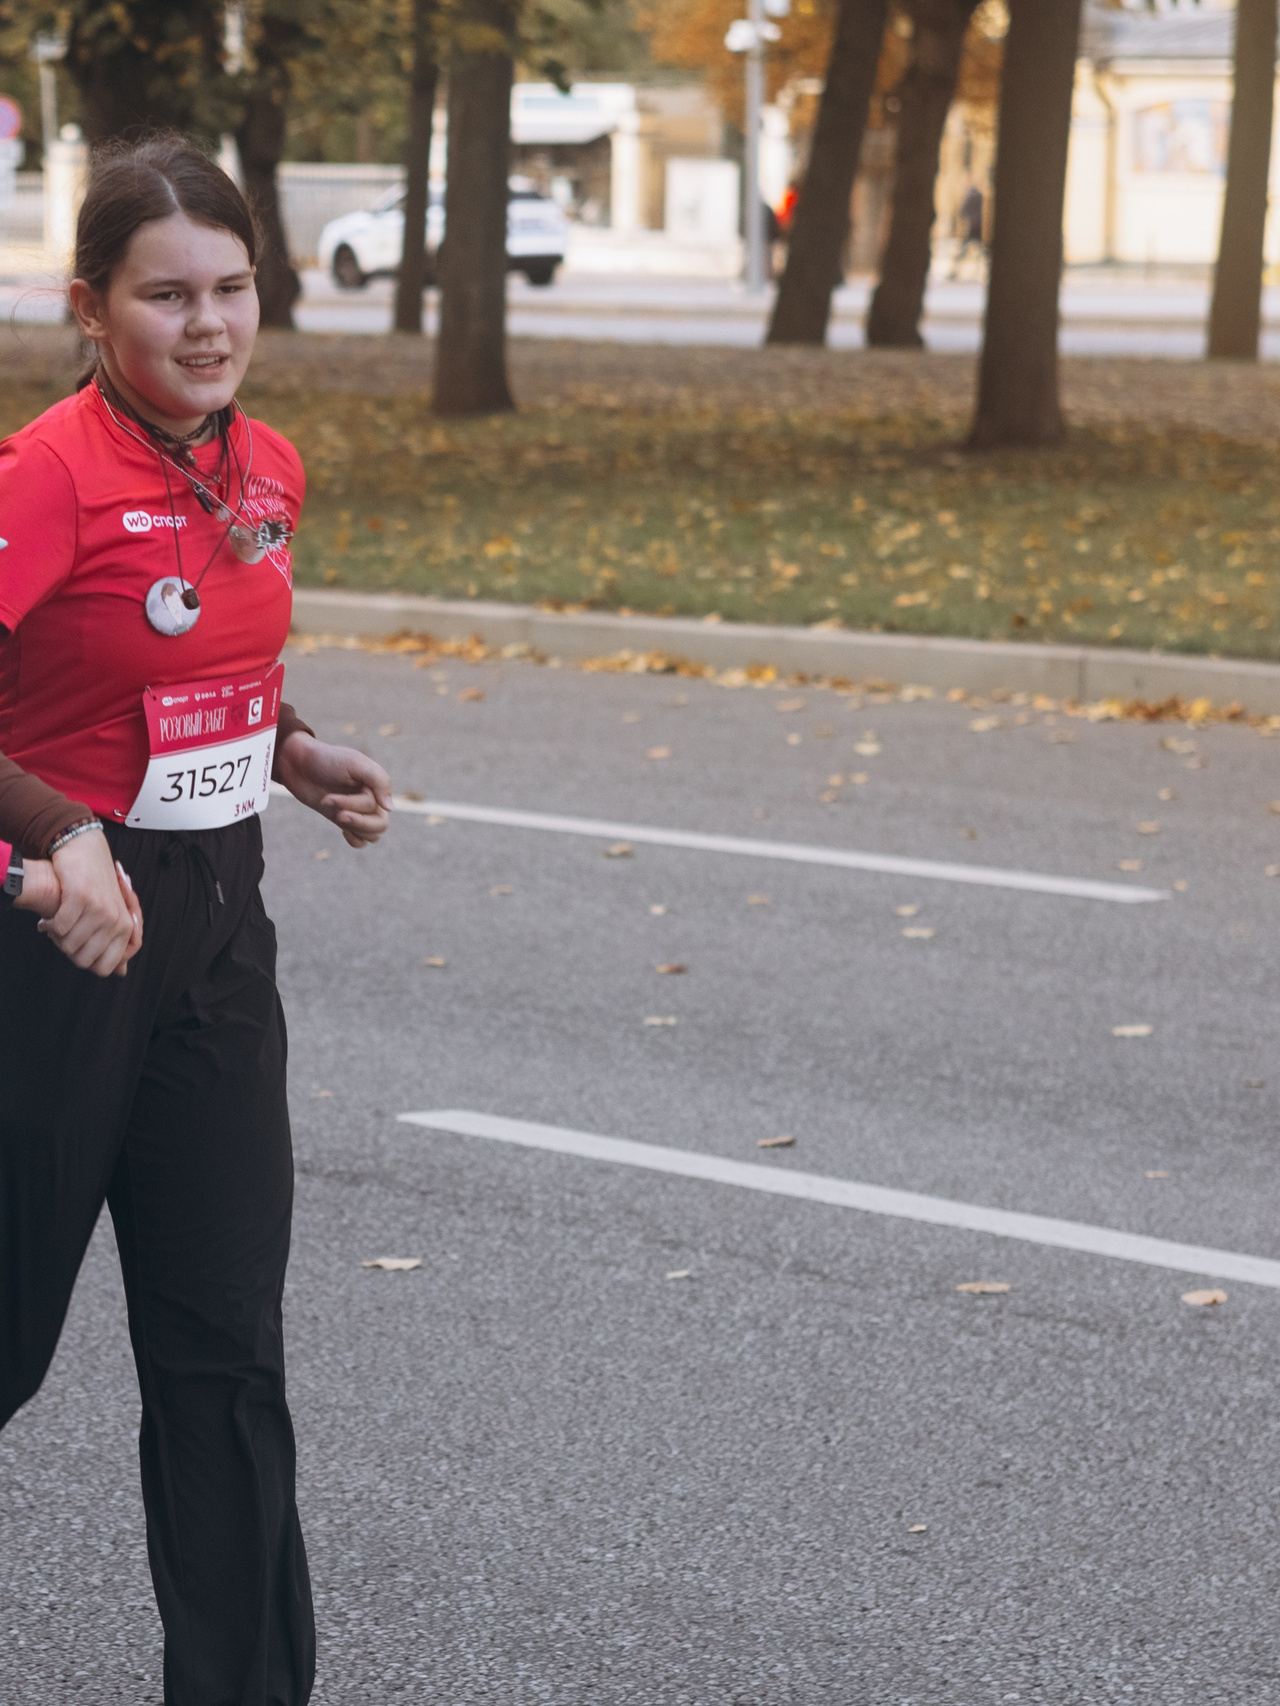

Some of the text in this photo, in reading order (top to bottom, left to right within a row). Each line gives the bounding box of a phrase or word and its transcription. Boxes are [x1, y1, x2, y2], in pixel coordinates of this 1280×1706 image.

[160, 707, 228, 742] РОЗОВЫЙ ЗАБЕГ
[160, 755, 251, 802] 31527
[262, 742, 271, 792] МОСКВА
[235, 804, 240, 817] 3
